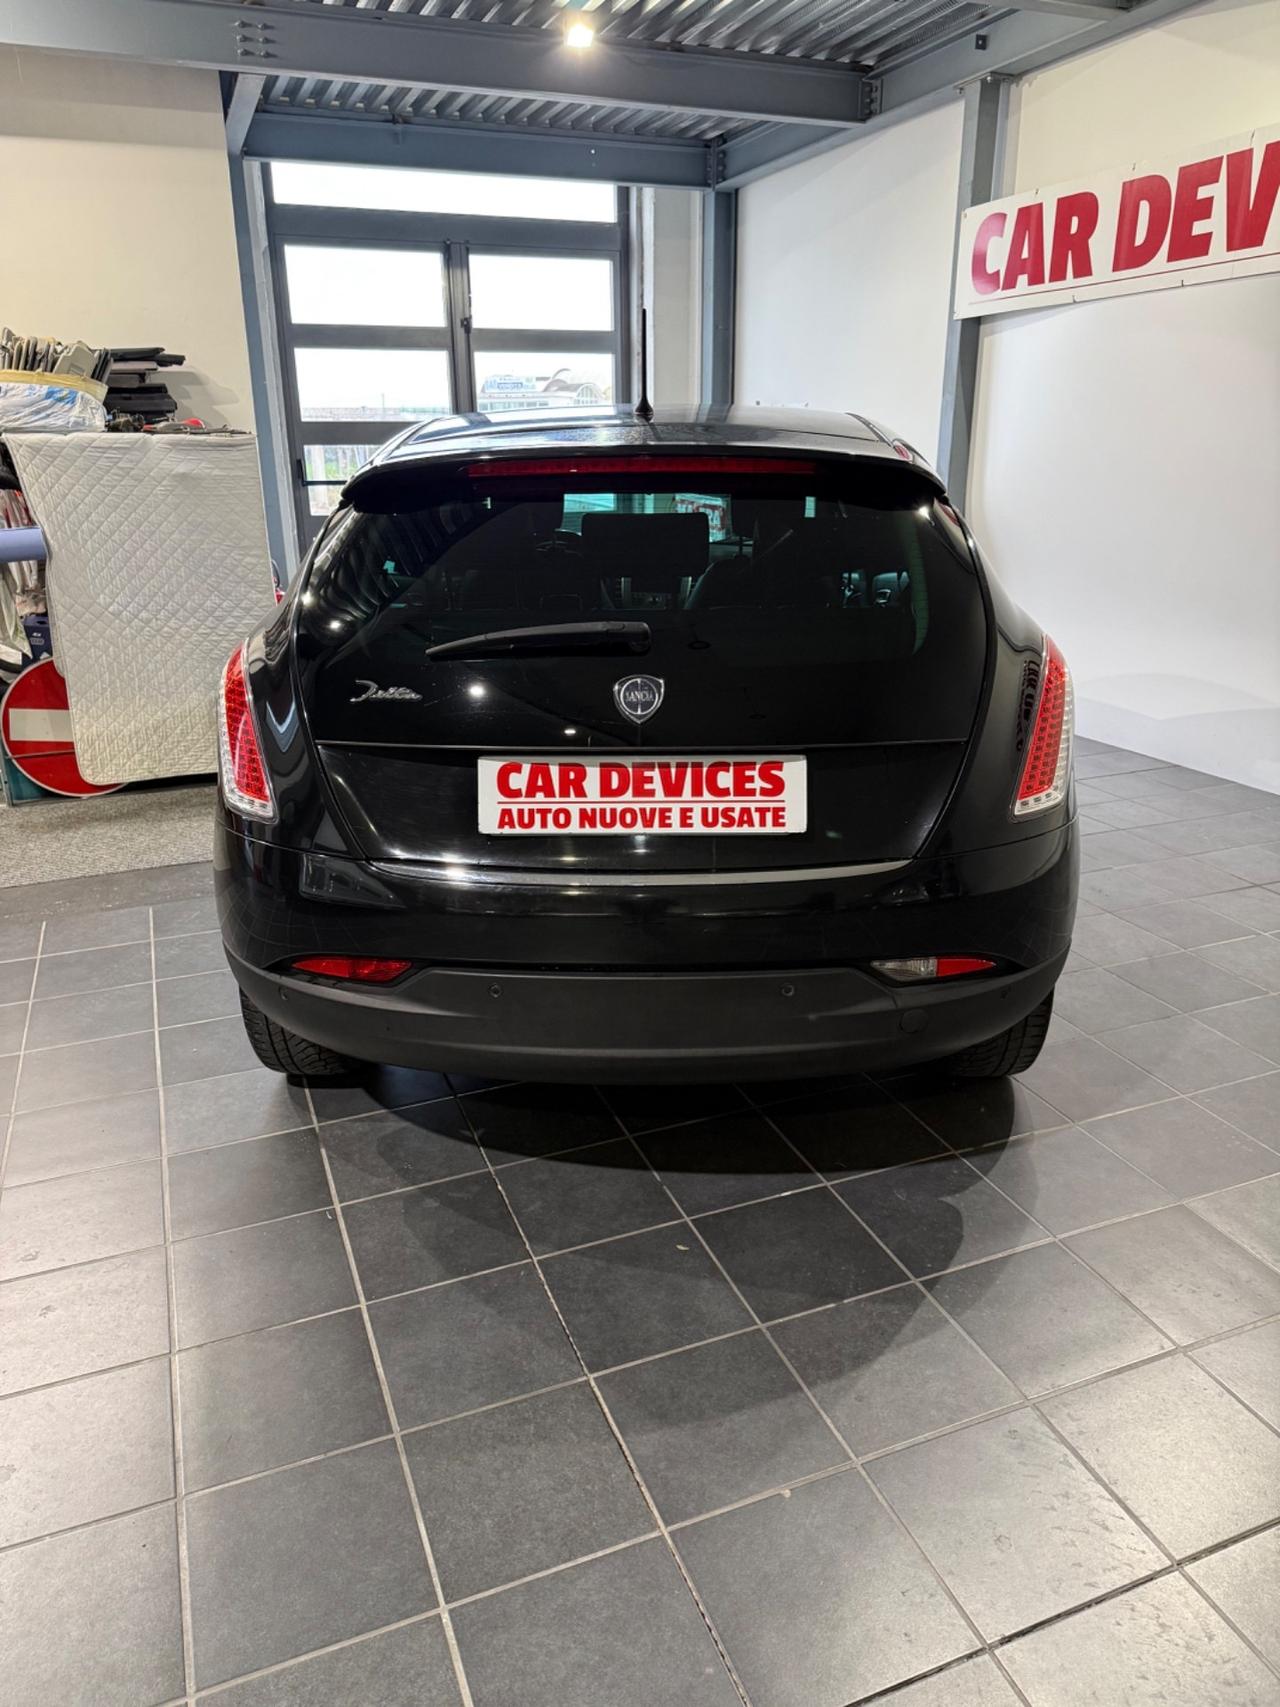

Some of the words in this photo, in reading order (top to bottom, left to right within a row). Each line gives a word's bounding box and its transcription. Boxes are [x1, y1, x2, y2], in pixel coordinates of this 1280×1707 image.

[971, 191, 1099, 295] CAR
[1112, 139, 1280, 273] DEV
[496, 761, 587, 799] CAR
[599, 761, 785, 798] DEVICES
[497, 807, 572, 829] AUTO
[578, 807, 673, 829] NUOVE
[679, 807, 694, 828] E
[701, 806, 786, 828] USATE
